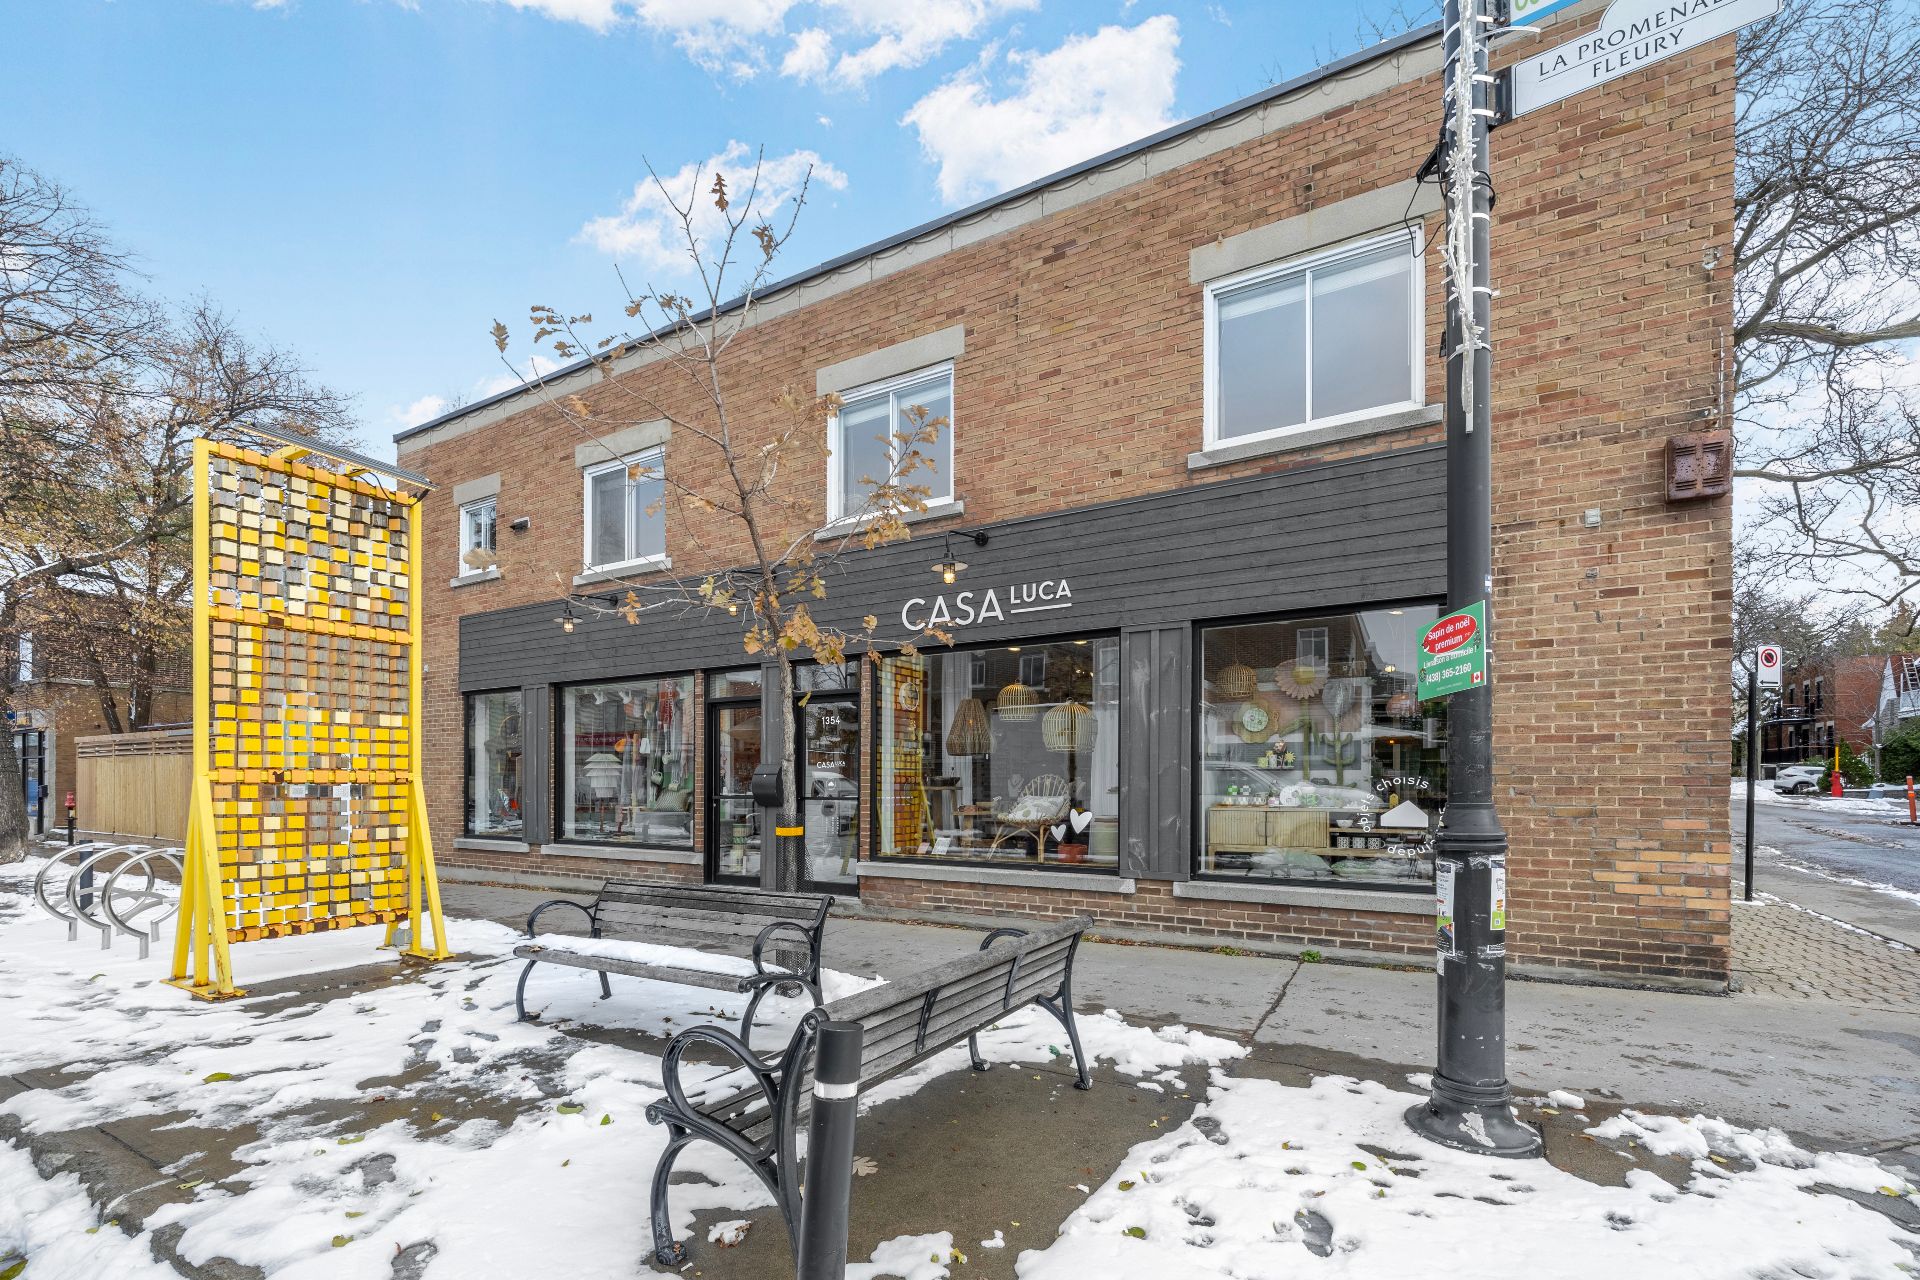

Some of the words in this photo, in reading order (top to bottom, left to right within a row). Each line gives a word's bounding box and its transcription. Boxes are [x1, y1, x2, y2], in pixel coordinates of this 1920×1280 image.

[1539, 55, 1568, 77] LA
[1578, 0, 1722, 60] PROMENA
[1592, 28, 1684, 78] FLEURY
[901, 588, 1004, 631] CASA
[1010, 579, 1072, 604] LUCA
[1428, 628, 1445, 642] Sapin
[1445, 623, 1454, 633] de
[1455, 616, 1470, 630] noël
[1435, 634, 1463, 653] premium
[1426, 669, 1441, 686] (438)
[821, 716, 841, 725] 1354
[816, 761, 835, 769] CASA
[1376, 775, 1430, 792] choisis
